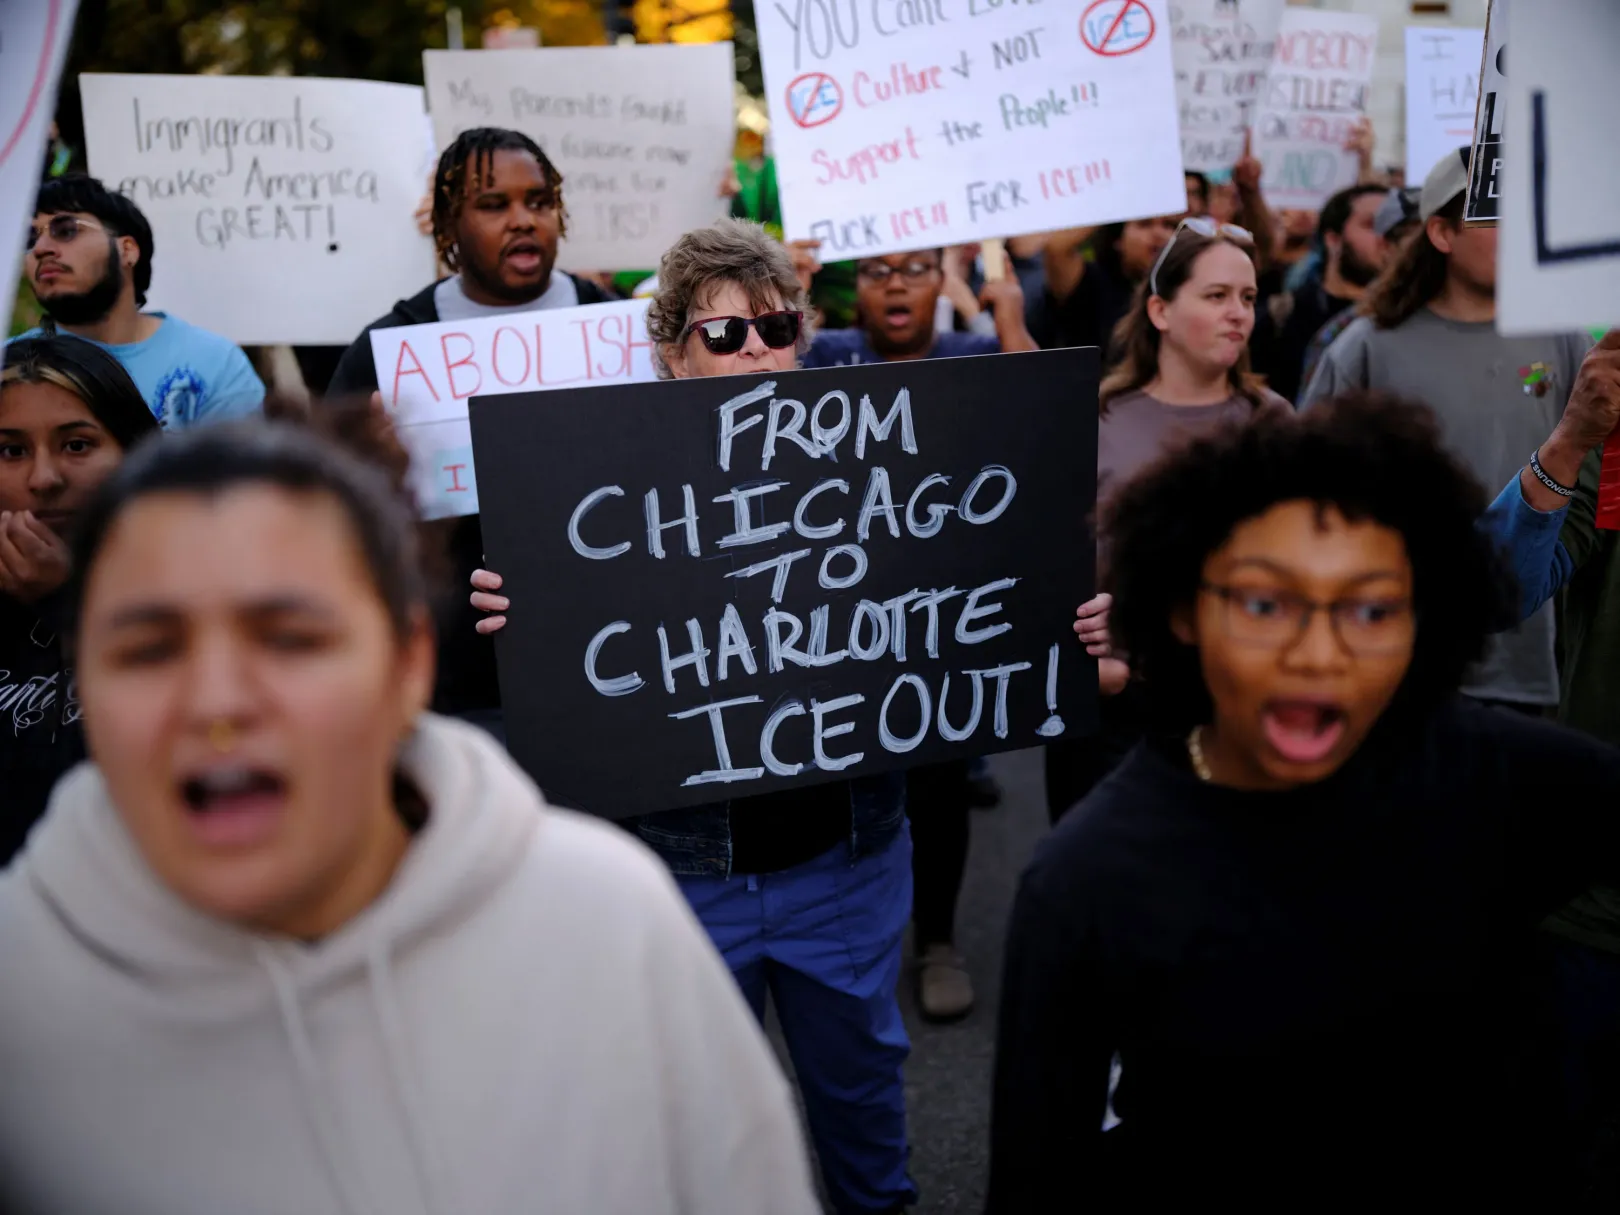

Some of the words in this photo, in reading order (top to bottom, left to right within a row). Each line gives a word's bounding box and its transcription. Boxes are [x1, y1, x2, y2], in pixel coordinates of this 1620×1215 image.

[852, 62, 945, 108] Culture
[991, 27, 1046, 70] NOT
[1431, 70, 1480, 108] HA
[133, 95, 333, 176] Immigrants
[811, 126, 921, 186] Support
[938, 120, 984, 148] the
[117, 168, 216, 200] make
[244, 156, 380, 202] America
[195, 204, 339, 254] GREAT!
[392, 313, 656, 407] ABOLISH
[714, 380, 919, 472] FROM
[566, 463, 1018, 560] CHICAGO
[723, 542, 869, 603] TO
[583, 576, 1023, 696] CHARLOTTE
[666, 692, 868, 788] ICE
[877, 642, 1067, 754] OUT!
